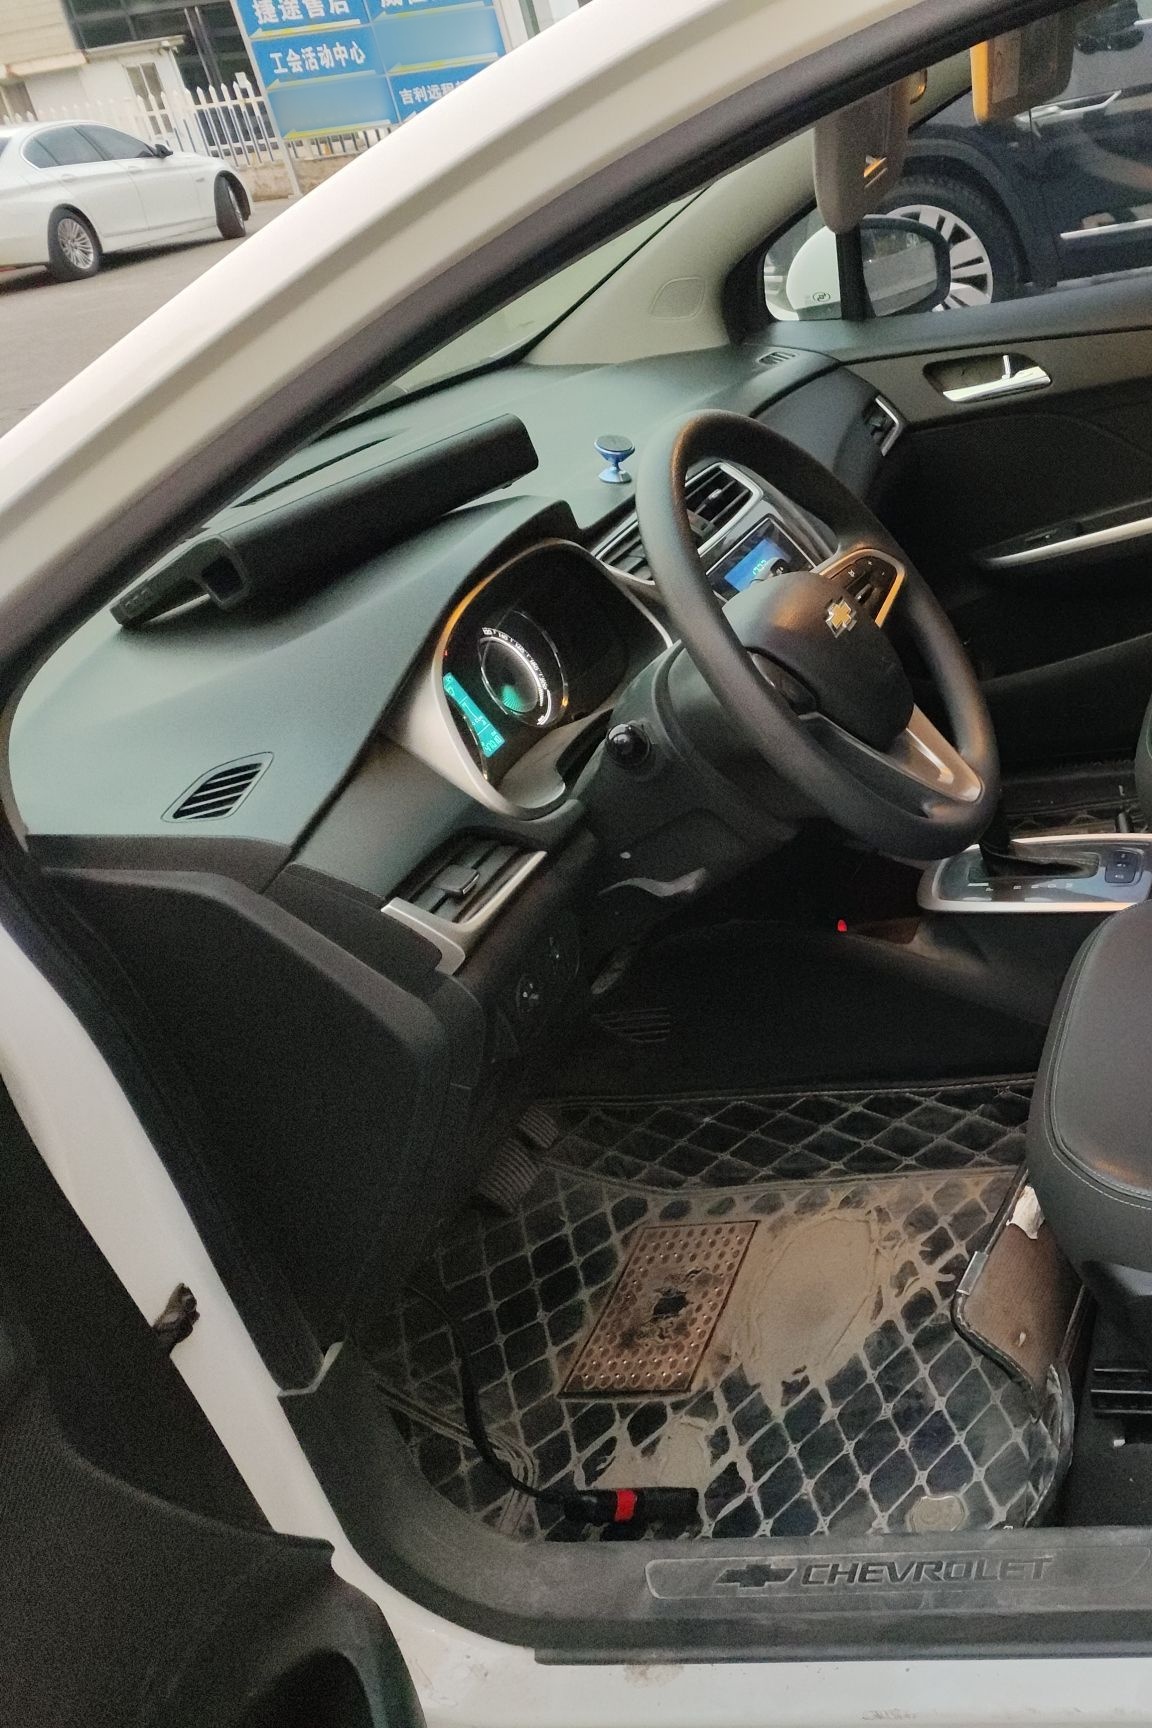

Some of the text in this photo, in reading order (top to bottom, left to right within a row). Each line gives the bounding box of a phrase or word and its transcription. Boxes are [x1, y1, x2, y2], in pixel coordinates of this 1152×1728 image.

[270, 41, 366, 73] 工会活动中心
[399, 81, 465, 104] 吉利远程
[801, 1556, 1053, 1586] CHEVROLET
